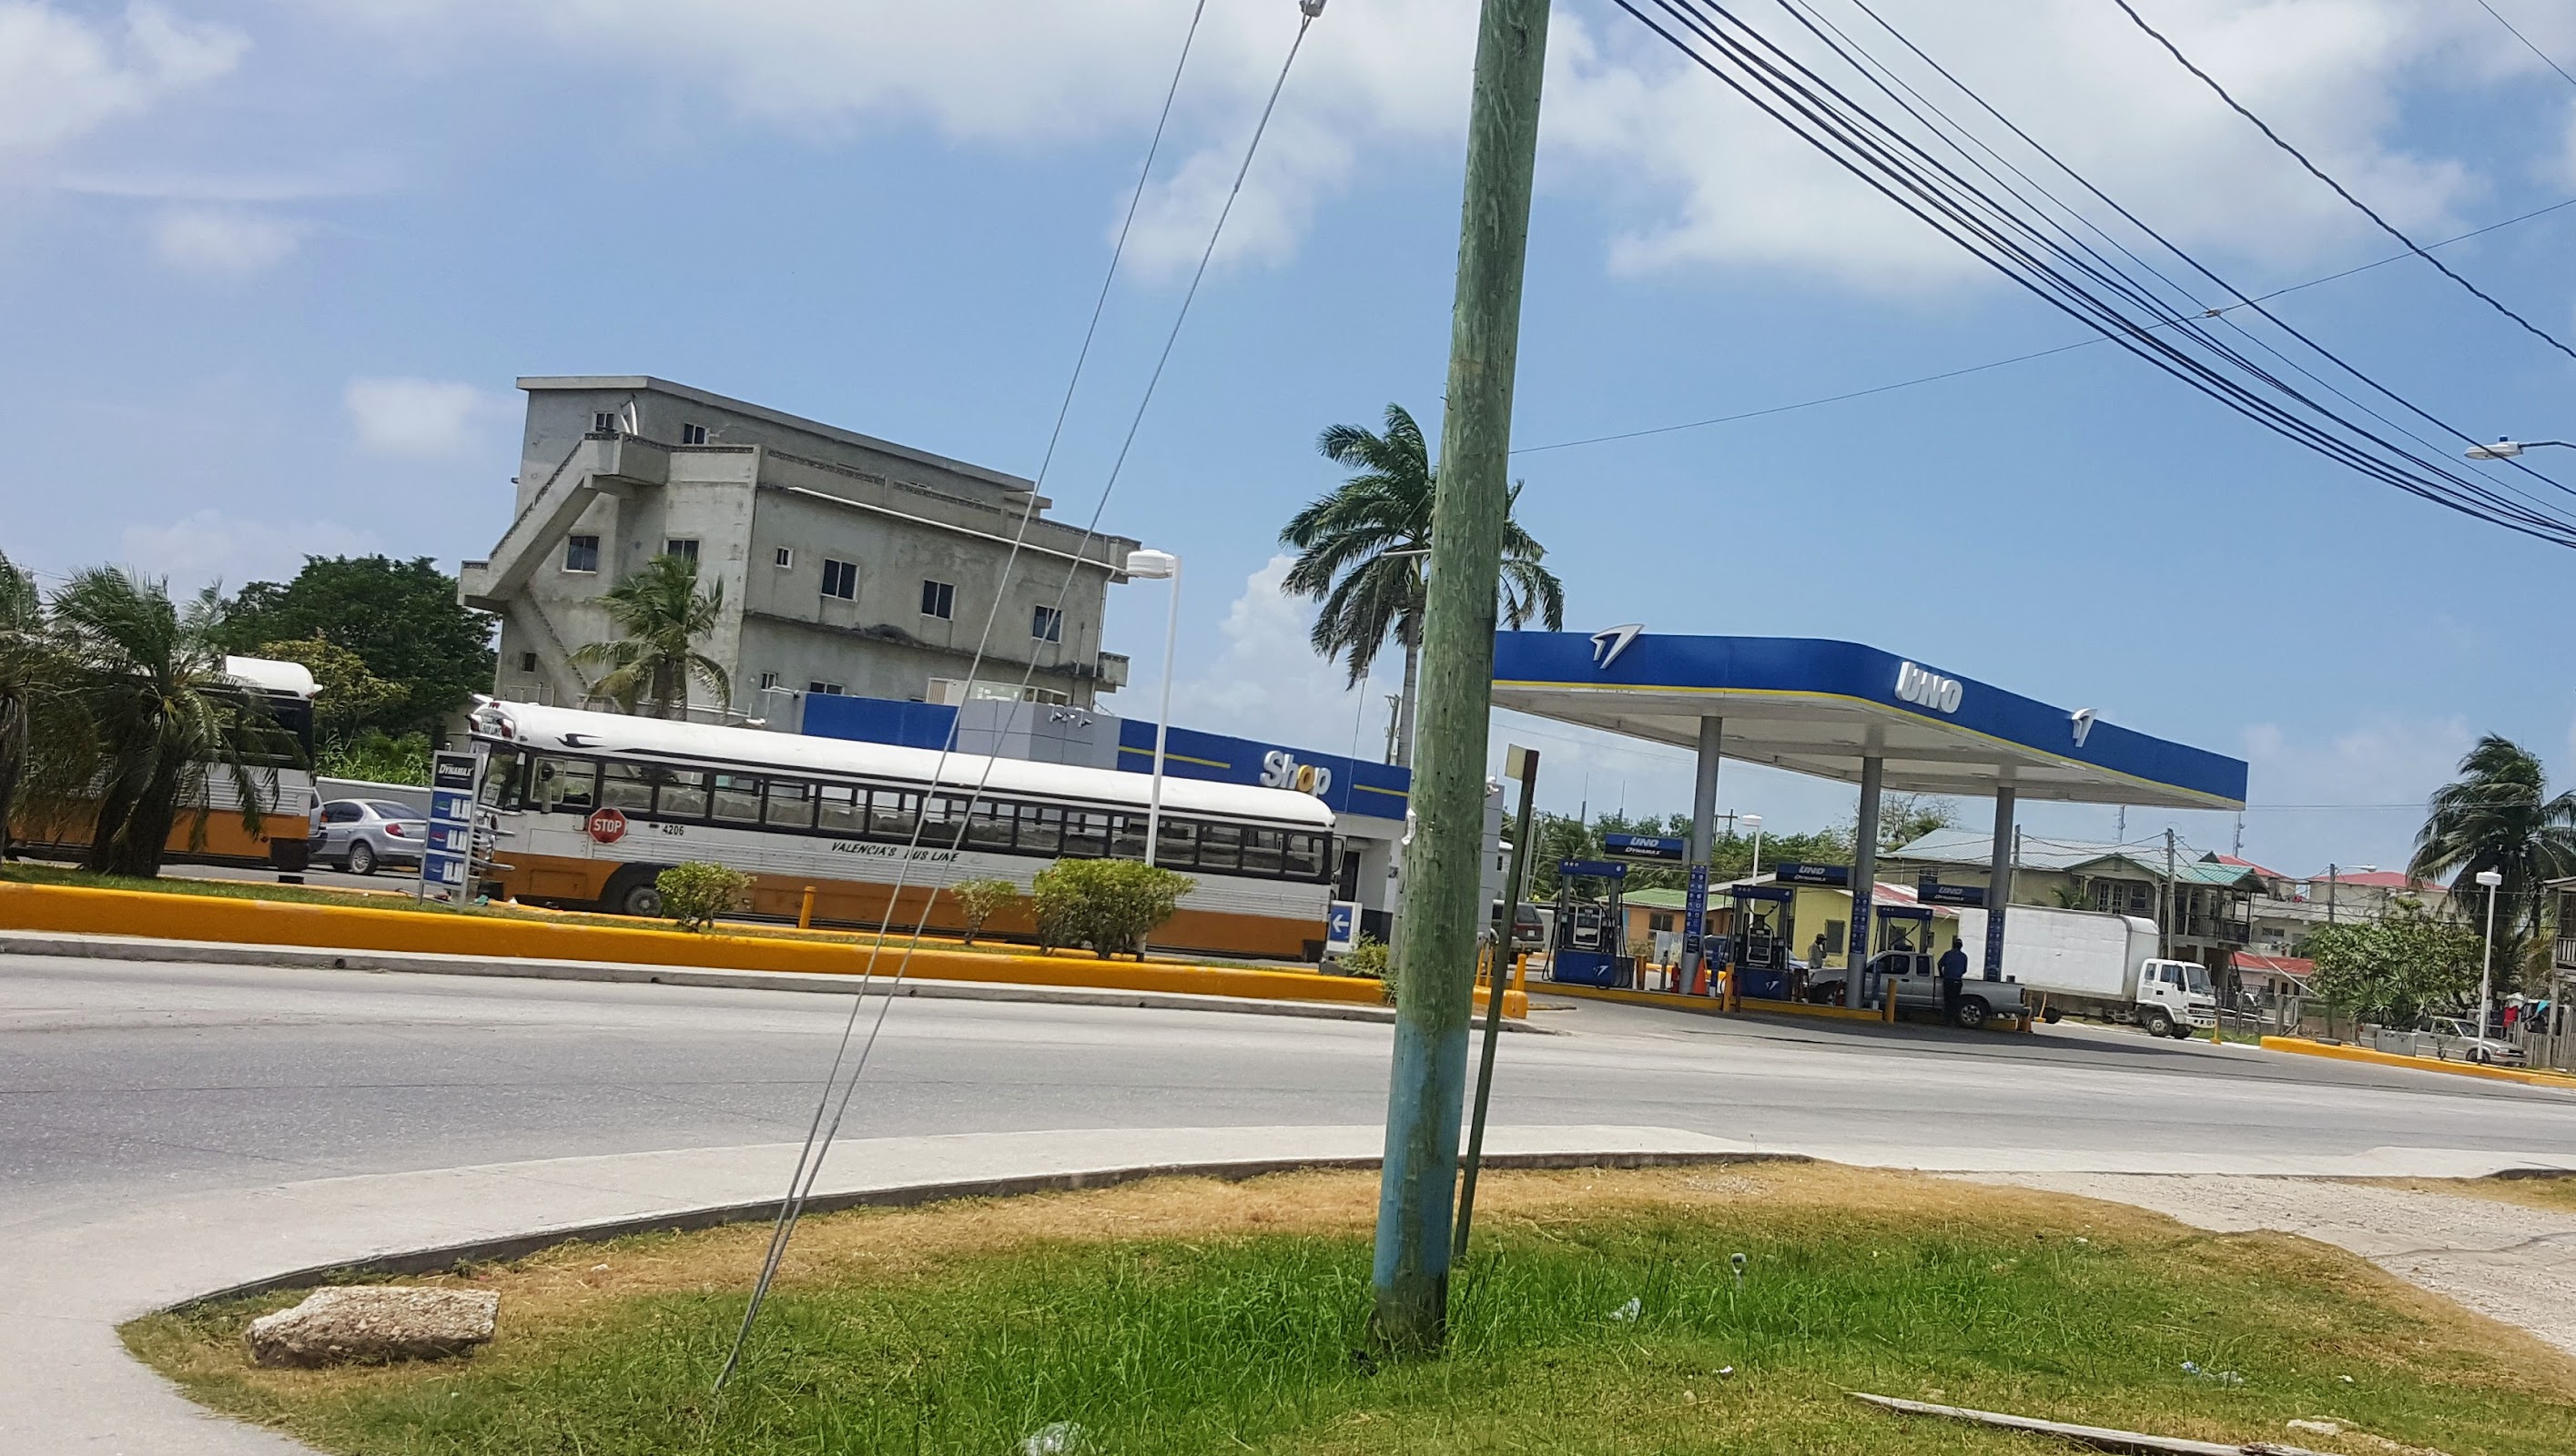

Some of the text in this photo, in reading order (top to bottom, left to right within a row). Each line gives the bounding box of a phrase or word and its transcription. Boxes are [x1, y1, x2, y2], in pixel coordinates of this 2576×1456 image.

[1894, 662, 1963, 714] UNO
[1260, 751, 1332, 798] Shop
[593, 818, 623, 834] STOP
[662, 824, 685, 835] 4206
[1629, 836, 1659, 847] UNO
[831, 842, 898, 856] VALENCIA'S
[1624, 846, 1662, 855] DYNAMAX
[1799, 865, 1826, 875] UNO
